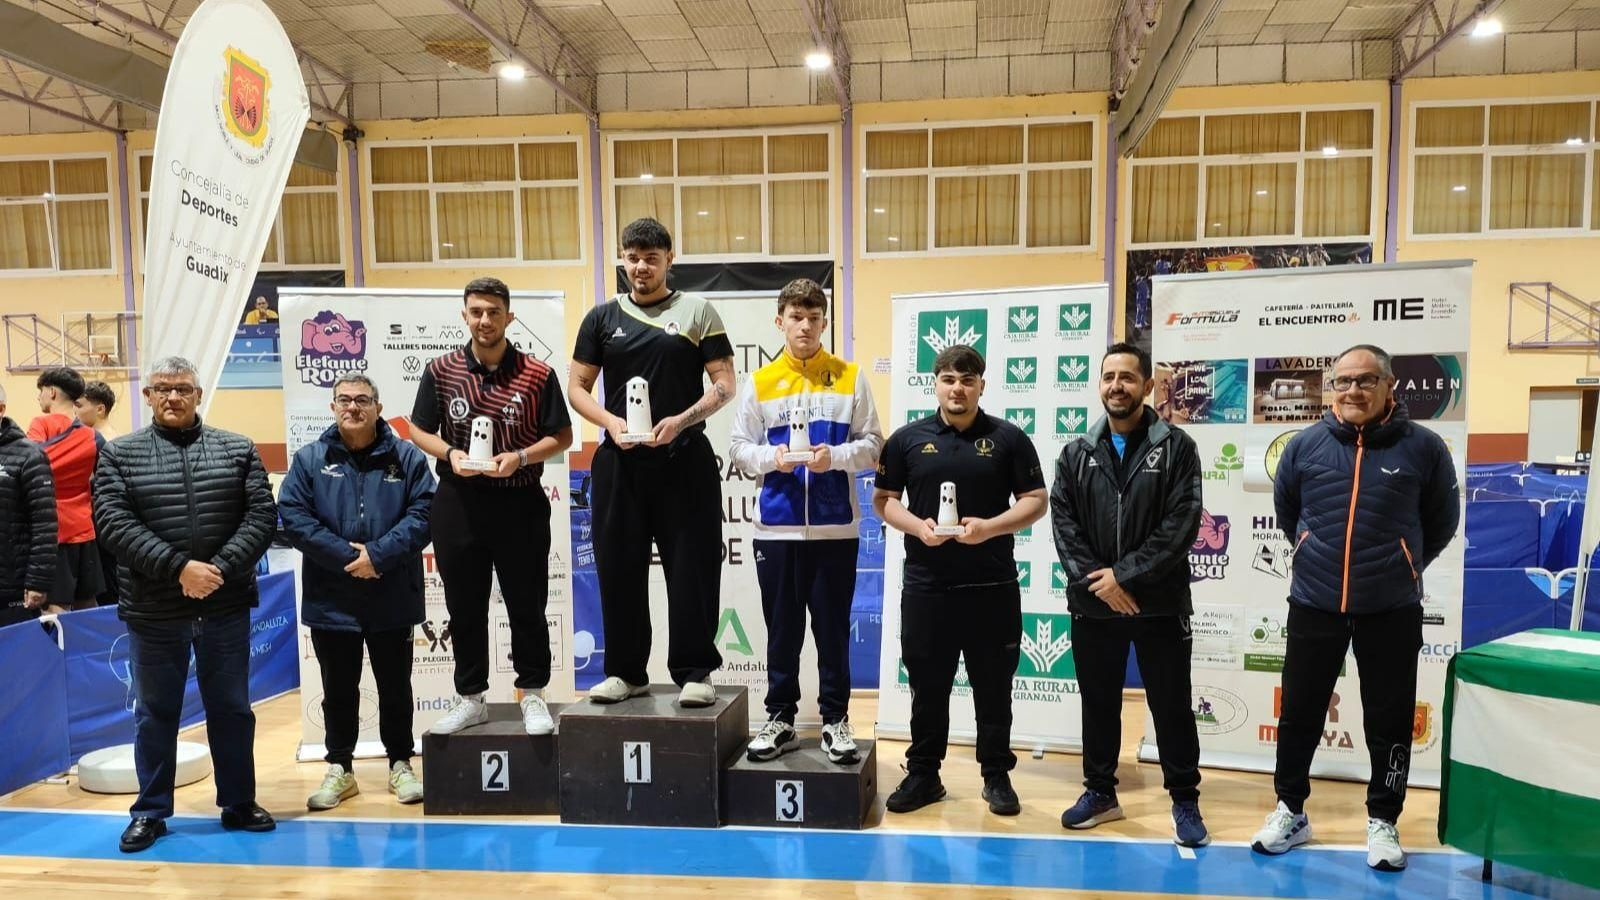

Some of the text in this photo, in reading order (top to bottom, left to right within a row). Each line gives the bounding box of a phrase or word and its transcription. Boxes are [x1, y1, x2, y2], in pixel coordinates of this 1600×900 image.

[181, 189, 238, 227] Deportes
[235, 192, 248, 209] de
[169, 230, 233, 266] Ayuntamiento
[186, 255, 229, 284] Guadix
[1265, 304, 1304, 312] CAFETERÍA
[1373, 298, 1424, 321] ME
[1259, 314, 1346, 326] EL ENCUENTRO
[297, 355, 368, 371] Elefante
[301, 367, 354, 385] Ros
[1013, 692, 1062, 703] GRANADA
[1033, 681, 1080, 694] RURAL
[487, 753, 504, 788] 2
[630, 744, 642, 780] 1
[782, 783, 799, 819] 3
